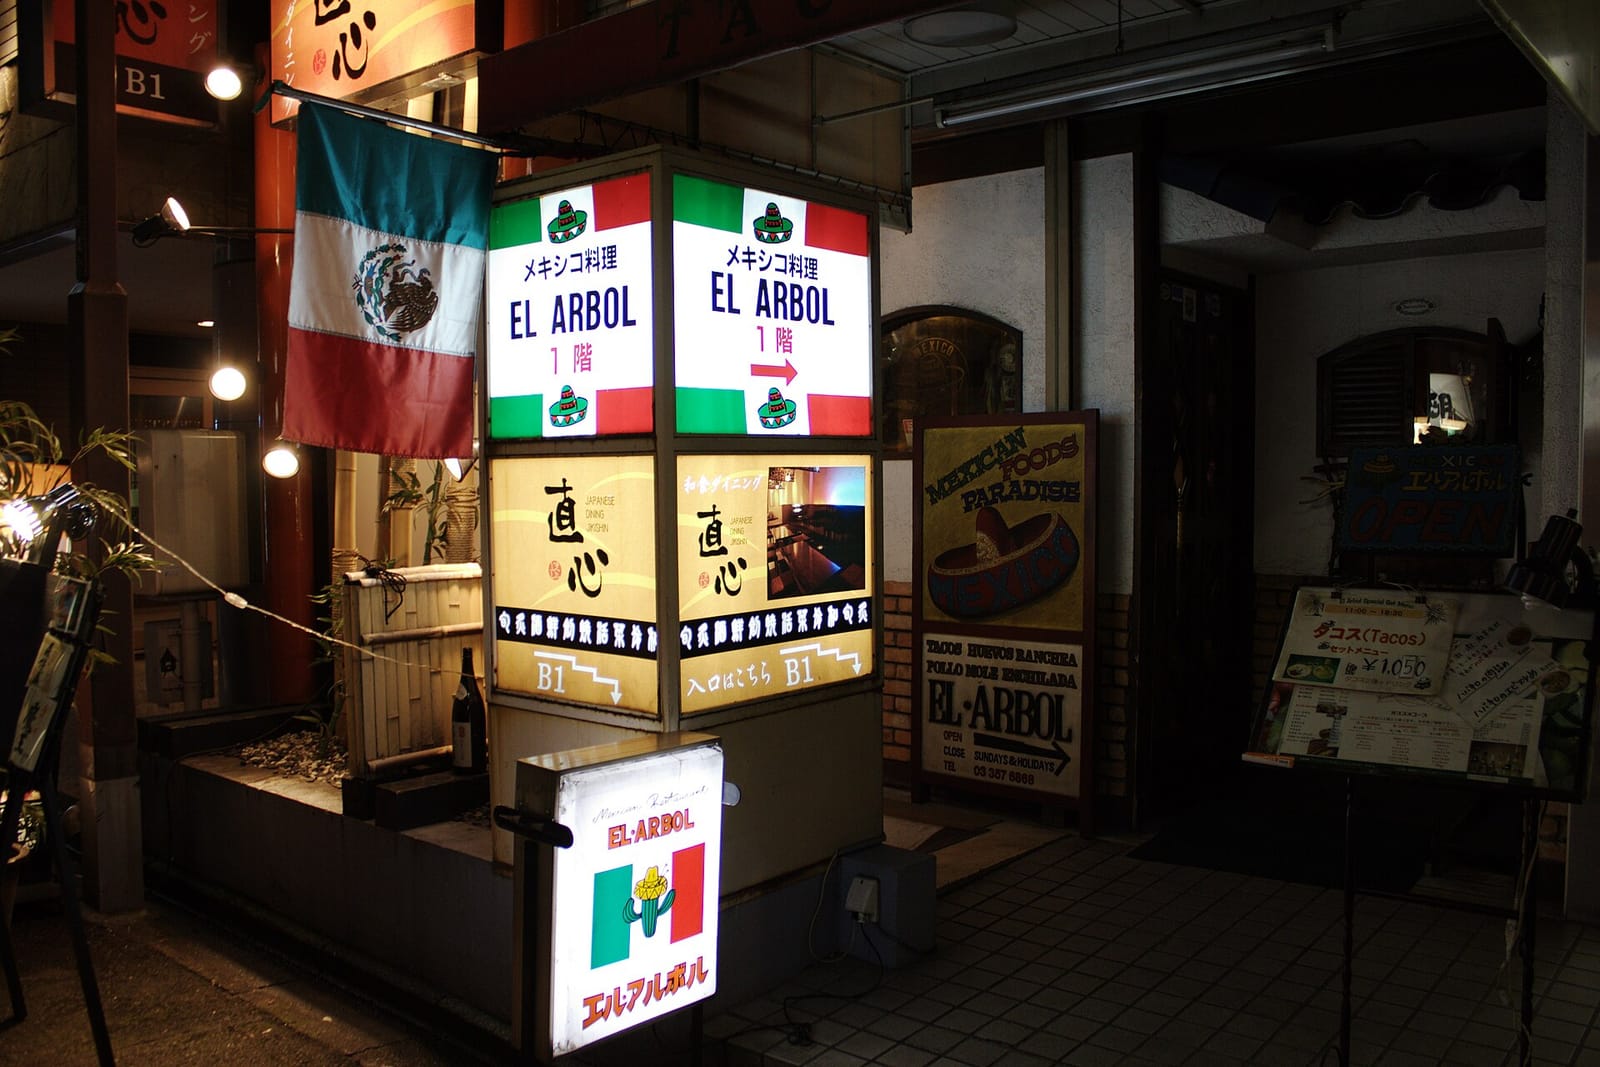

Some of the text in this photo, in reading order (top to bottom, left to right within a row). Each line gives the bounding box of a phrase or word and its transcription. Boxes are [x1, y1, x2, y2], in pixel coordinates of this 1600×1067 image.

[124, 66, 166, 100] B1
[524, 244, 618, 282] メキシコ料理
[727, 244, 818, 281] メキシコ料理
[510, 285, 637, 340] EL ARBOL
[711, 270, 835, 326] EL ARBOL
[925, 426, 1028, 505] MEXICAN
[999, 432, 1080, 481] FOODS
[683, 474, 763, 495] 和食ダイニング
[961, 479, 1081, 513] PARADISE
[1349, 495, 1506, 544] OPEN
[931, 526, 1078, 614] MEXICO
[926, 639, 963, 656] TACOS
[967, 643, 1014, 661] HUEVOS
[1329, 644, 1389, 656] セットメニュー
[537, 662, 566, 694] B1
[687, 655, 815, 697] 入口はこちら B1
[926, 660, 1078, 690] POLLO MOLE ENCHILADA
[943, 730, 963, 743] OPEN
[943, 745, 966, 759] CLOSE
[943, 760, 957, 772] TEL
